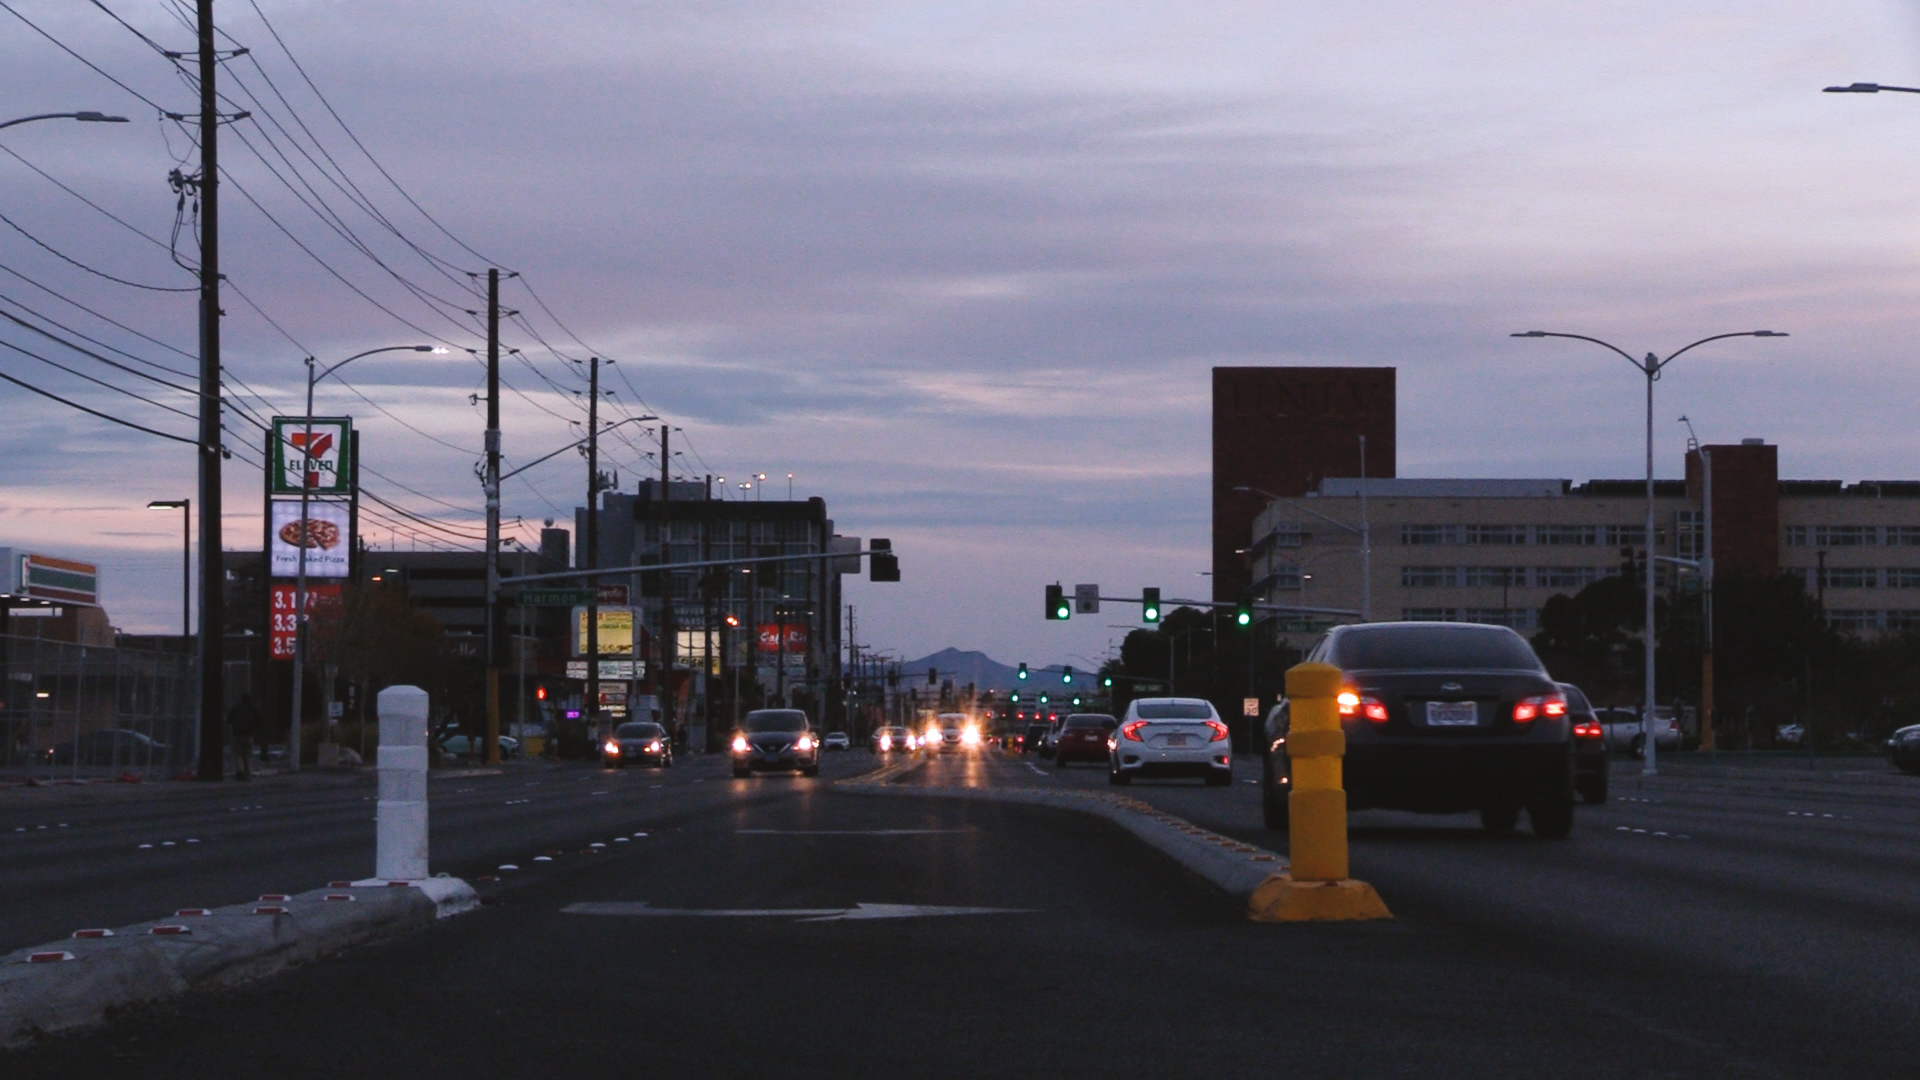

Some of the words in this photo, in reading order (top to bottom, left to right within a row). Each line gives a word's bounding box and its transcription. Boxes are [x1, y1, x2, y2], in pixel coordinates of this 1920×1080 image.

[276, 555, 298, 563] Fresh
[303, 555, 323, 563] aked
[324, 555, 345, 563] Pizza
[522, 592, 578, 604] Harmon
